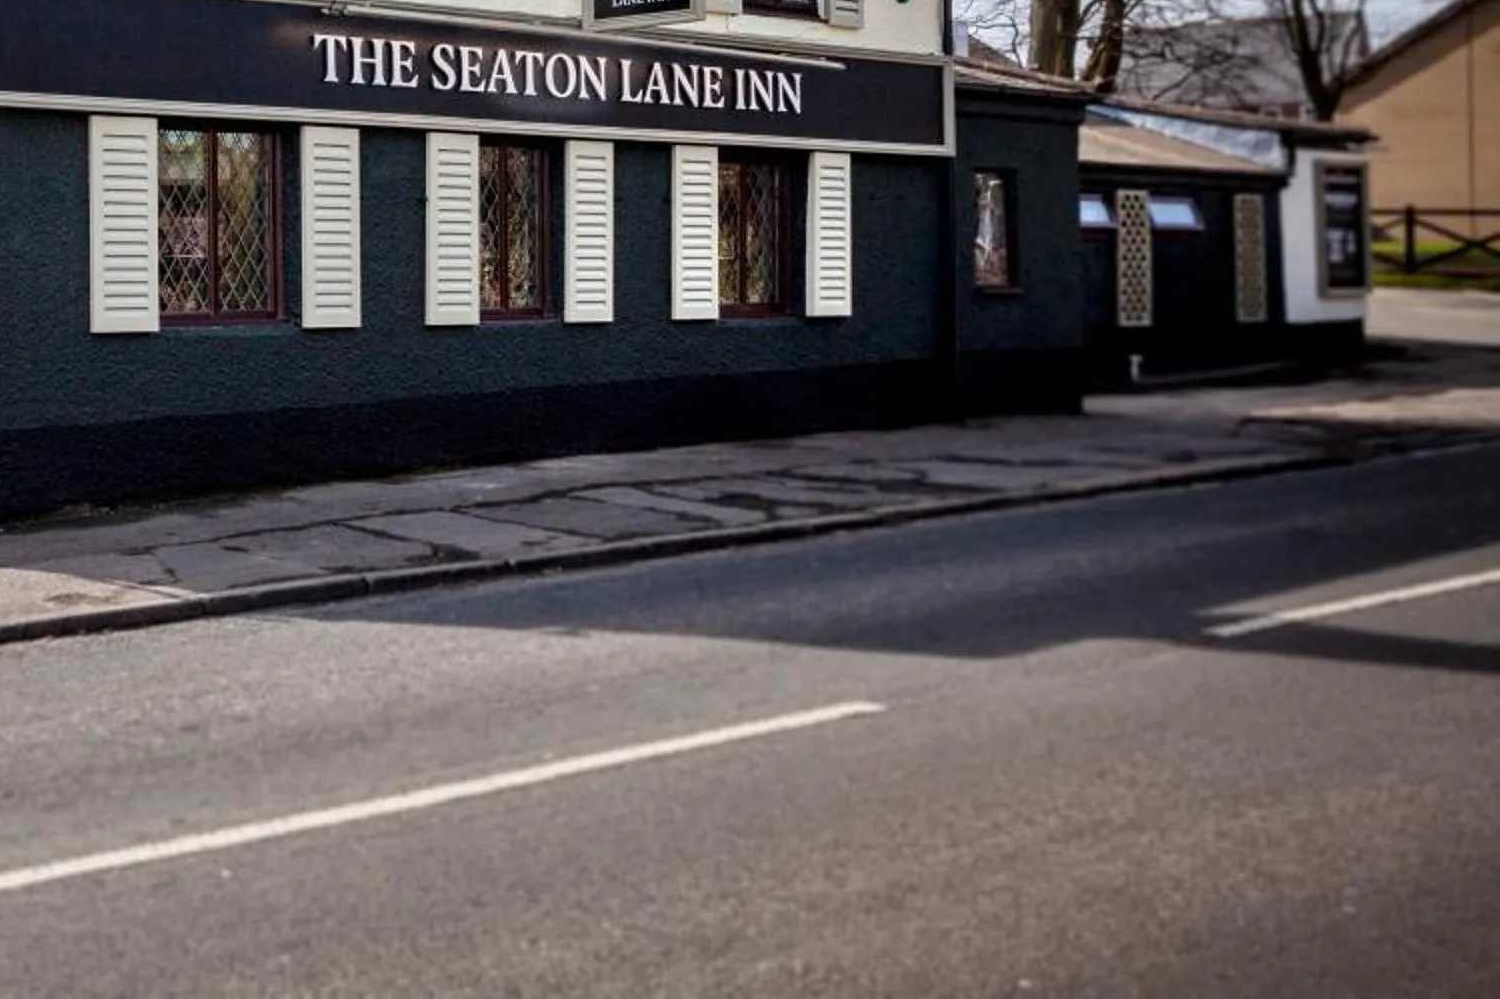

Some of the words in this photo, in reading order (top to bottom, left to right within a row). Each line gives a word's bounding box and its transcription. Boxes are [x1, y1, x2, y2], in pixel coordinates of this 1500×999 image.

[313, 34, 419, 88] THE
[432, 42, 608, 102] SEATON
[620, 59, 725, 109] LANE
[735, 68, 803, 114] INN
